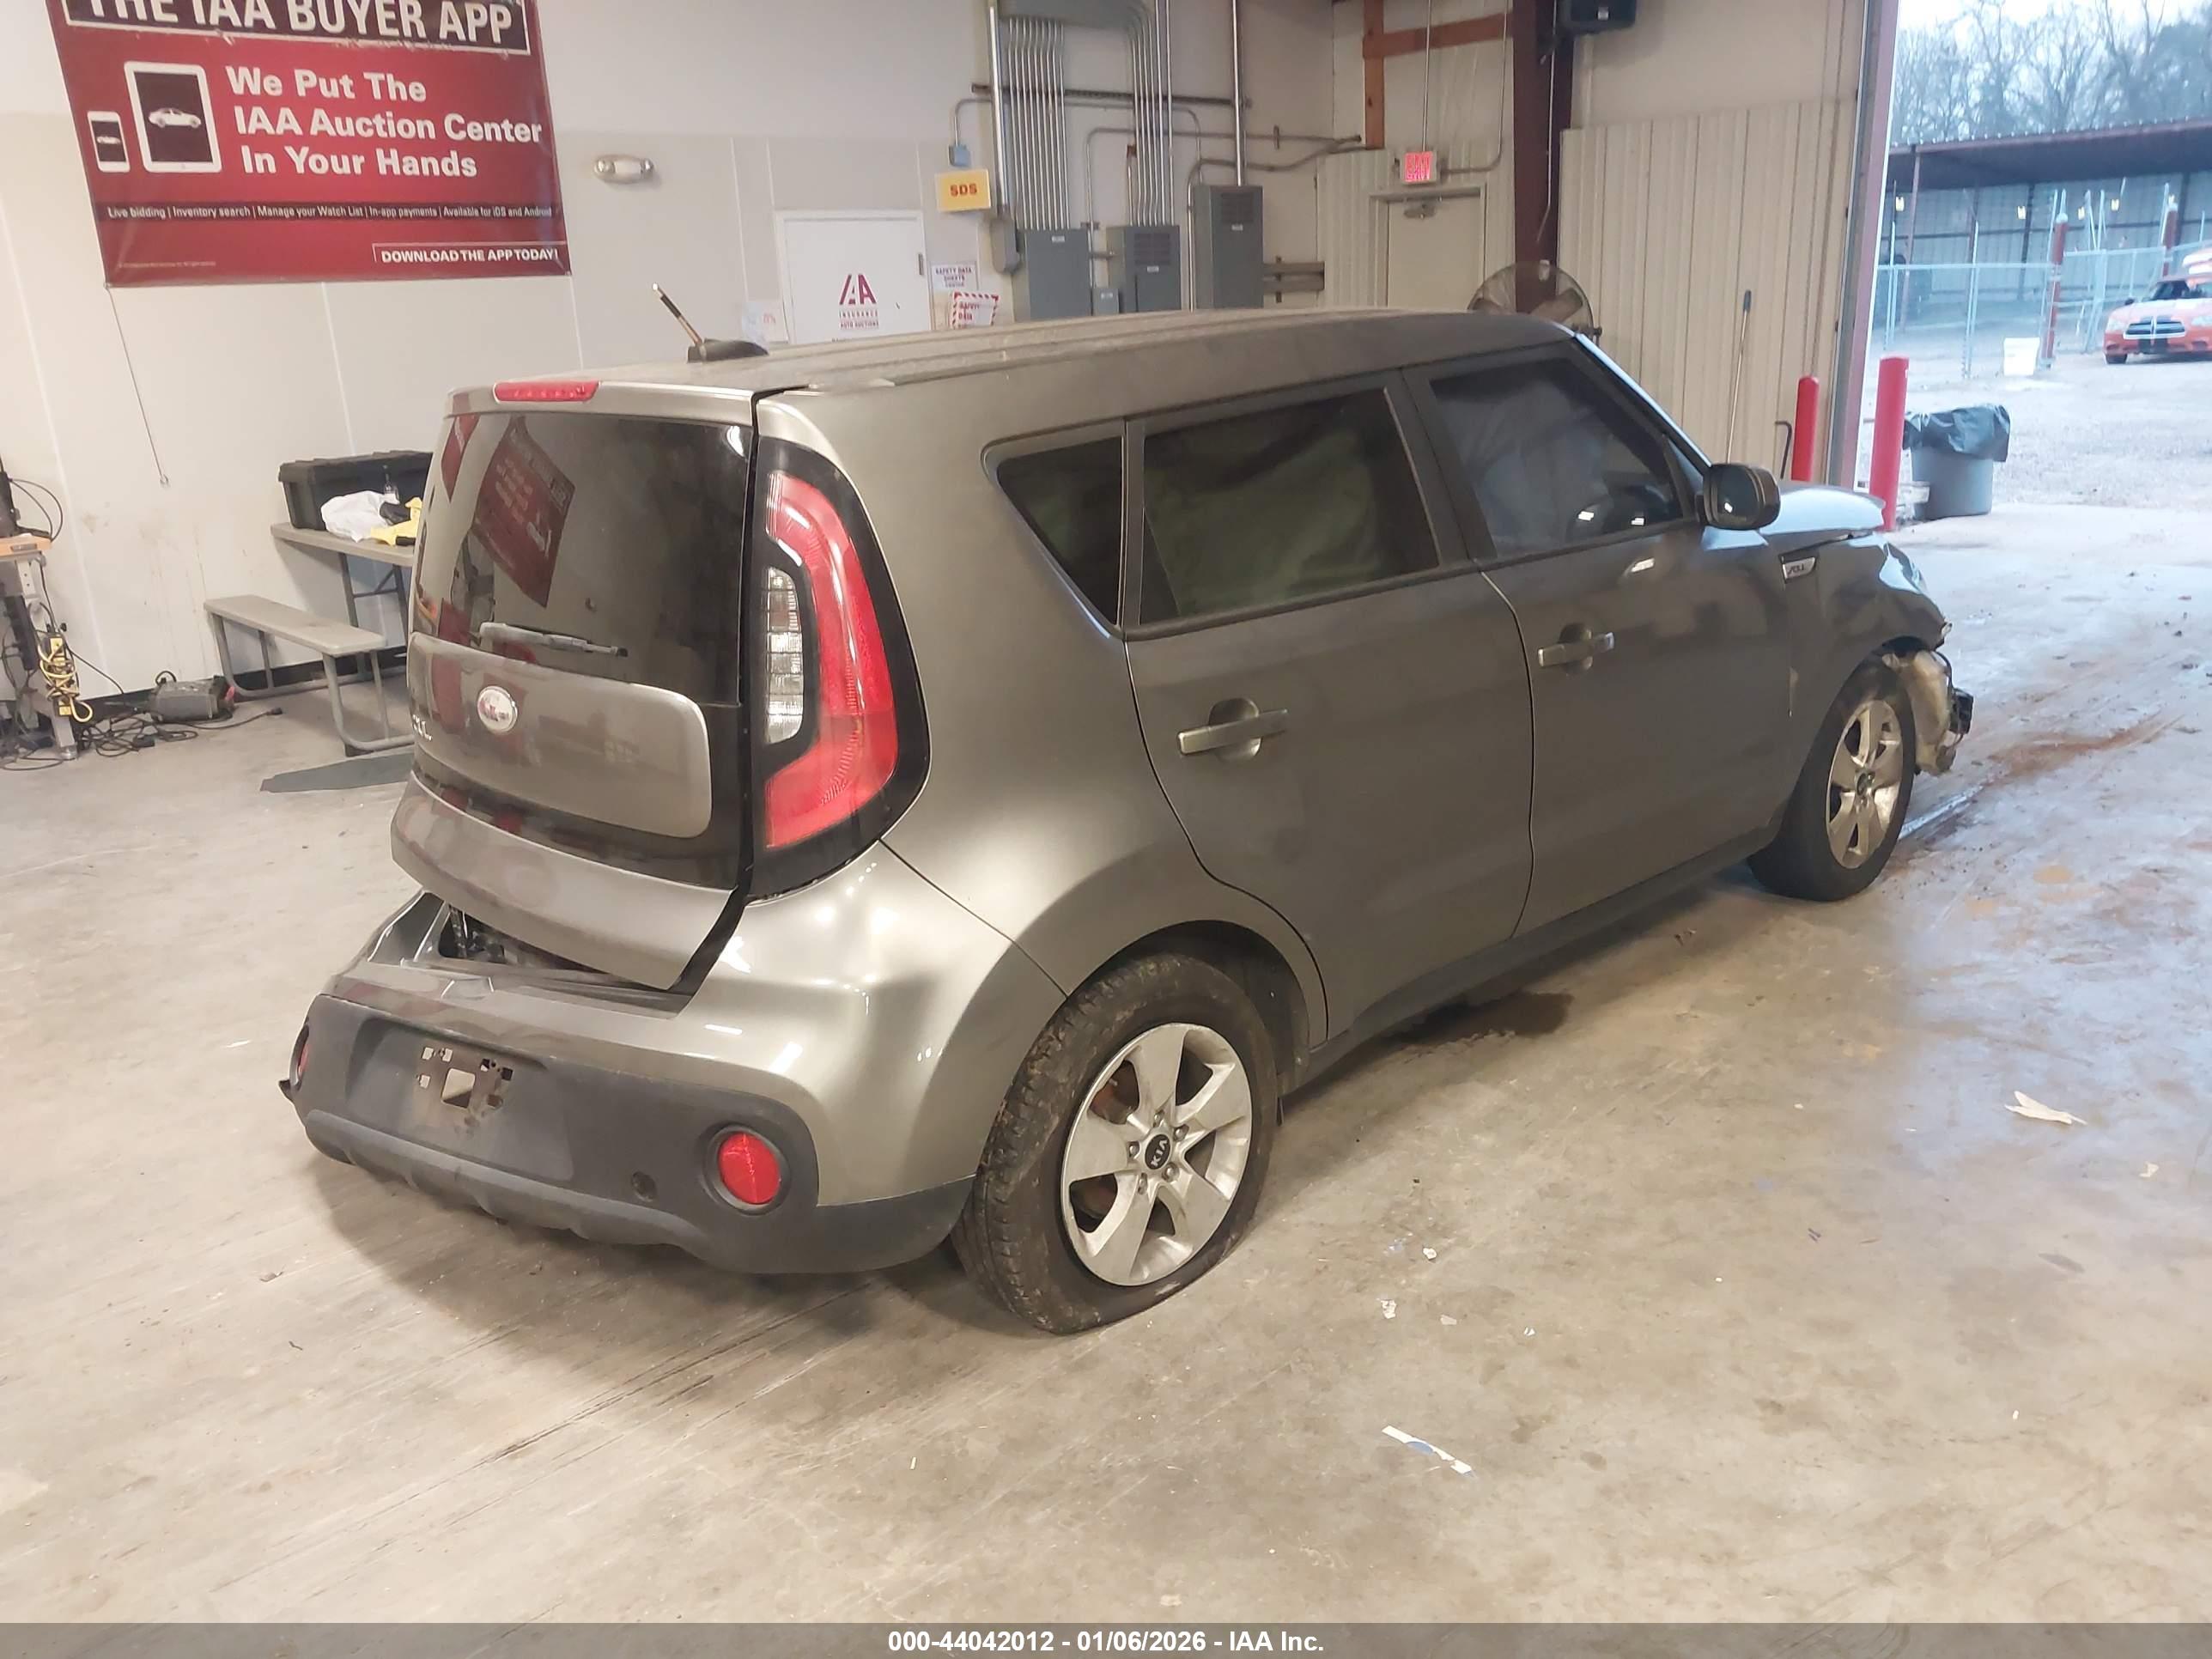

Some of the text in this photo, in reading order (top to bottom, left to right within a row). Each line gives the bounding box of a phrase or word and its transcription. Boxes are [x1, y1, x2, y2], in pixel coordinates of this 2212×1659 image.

[191, 0, 276, 29] IAA
[286, 0, 428, 40] BUYER
[438, 1, 514, 44] APP
[224, 65, 427, 102] We Put The
[234, 105, 543, 143] IAA Auction Center
[240, 144, 477, 178] In Your Hands
[950, 184, 977, 197] SDS
[106, 206, 128, 218] Live
[130, 205, 166, 219] bidding
[173, 205, 216, 218] Inventory
[218, 205, 251, 218] search
[258, 205, 295, 218] Manage
[296, 206, 316, 218] your
[317, 205, 345, 217] Watch
[347, 205, 363, 217] List
[369, 205, 397, 218] In-app
[398, 206, 437, 218] payments
[443, 205, 479, 217] Available
[480, 205, 492, 217] for
[492, 205, 507, 217] iOS
[507, 205, 523, 217] and
[524, 205, 552, 217] Android
[380, 248, 558, 264] DOWNLOAD THE APP TODAY!
[1151, 1139, 1168, 1167] KIA
